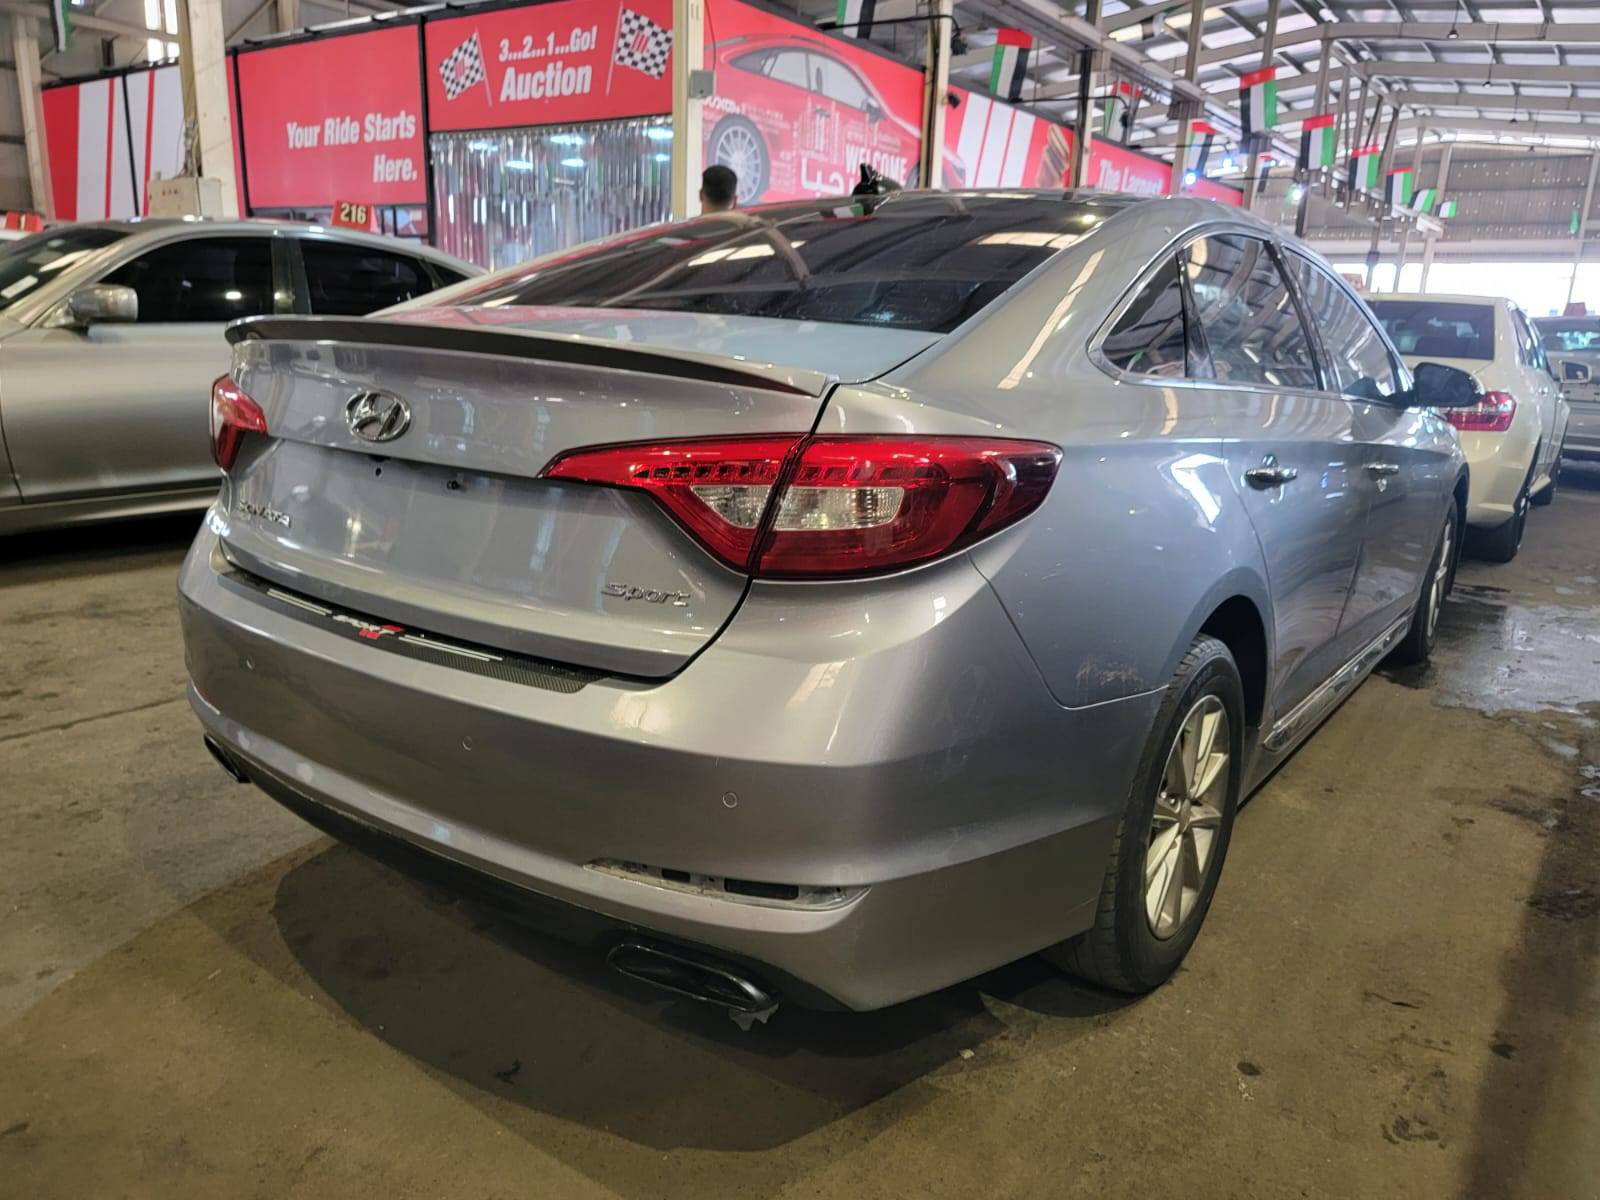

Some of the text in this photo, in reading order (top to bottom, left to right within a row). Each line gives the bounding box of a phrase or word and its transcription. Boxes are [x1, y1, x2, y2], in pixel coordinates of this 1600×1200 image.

[499, 60, 593, 103] Auction
[286, 109, 416, 149] Your Ride Starts
[372, 153, 418, 183] Here.
[1100, 159, 1121, 193] The
[340, 202, 368, 225] 216
[600, 582, 690, 607] Sport
